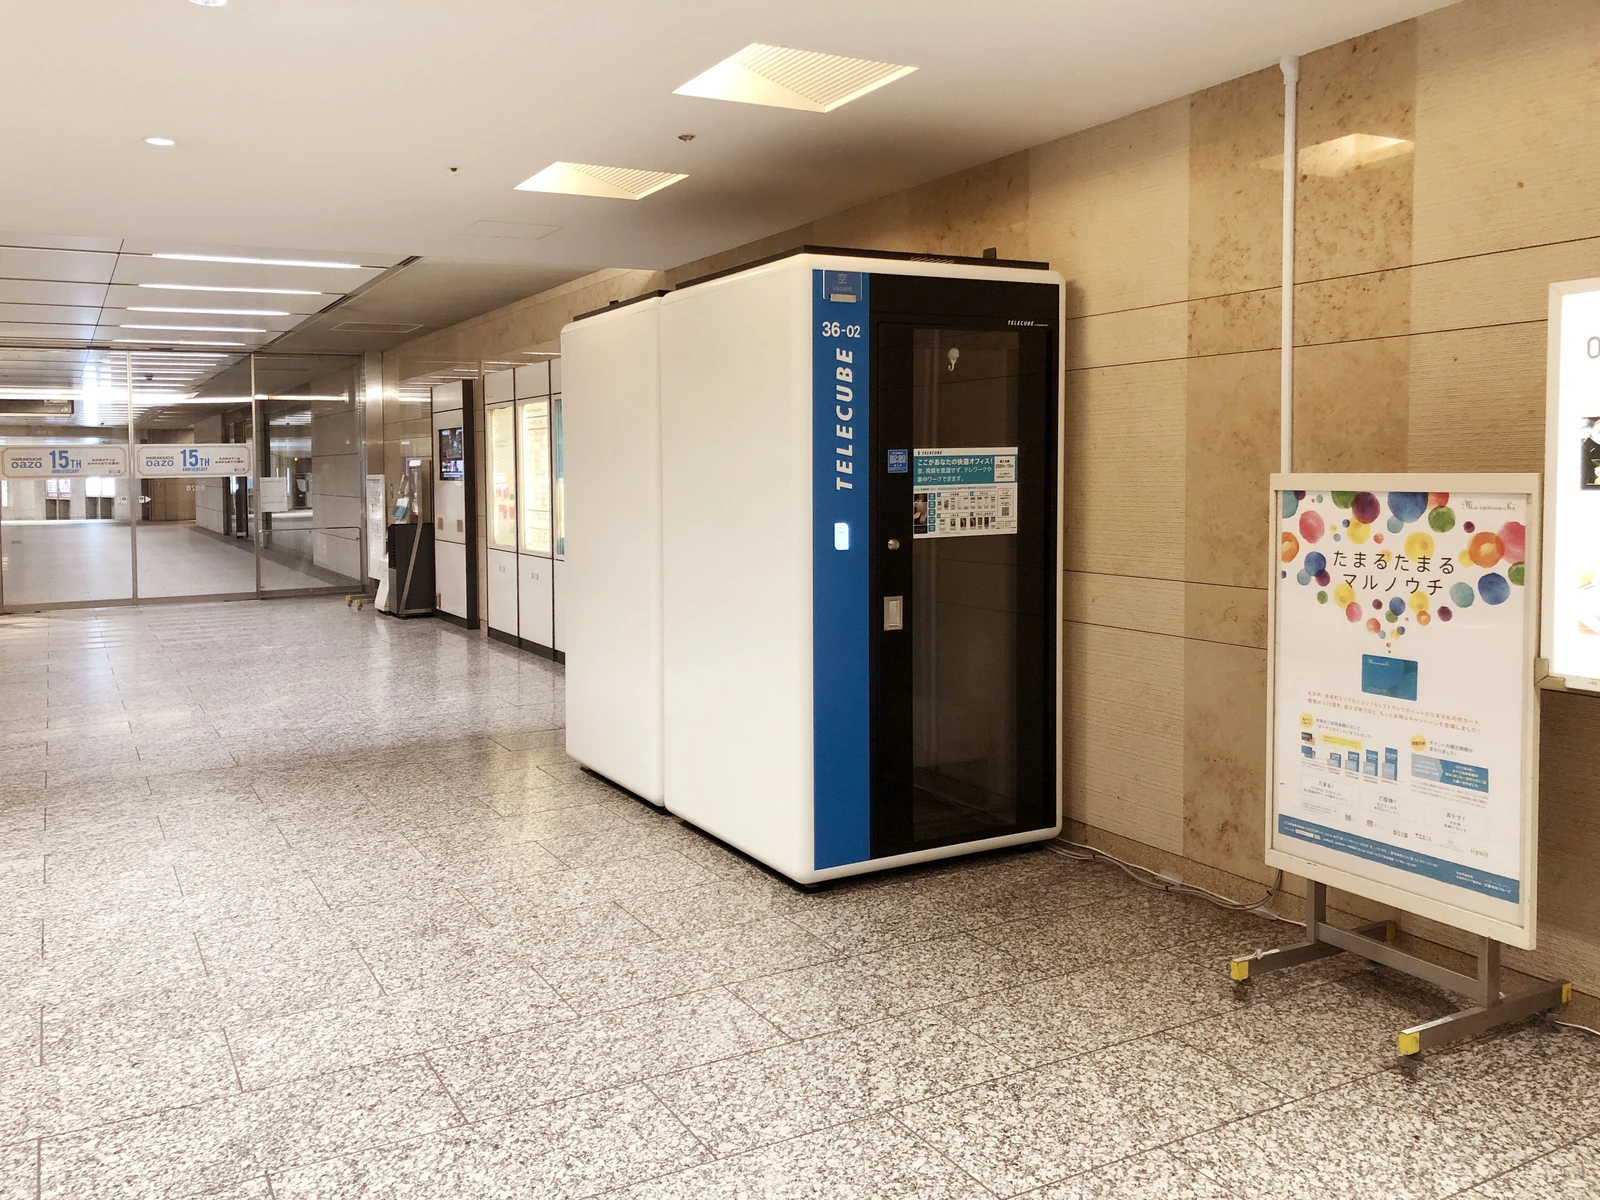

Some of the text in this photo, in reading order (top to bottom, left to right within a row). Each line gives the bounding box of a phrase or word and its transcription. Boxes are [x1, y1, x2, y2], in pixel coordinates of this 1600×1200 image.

[822, 321, 860, 338] 36-02
[835, 347, 853, 491] TELECUBE
[1333, 550, 1455, 575] たまるたまる
[1343, 573, 1444, 596] マルノウチ
